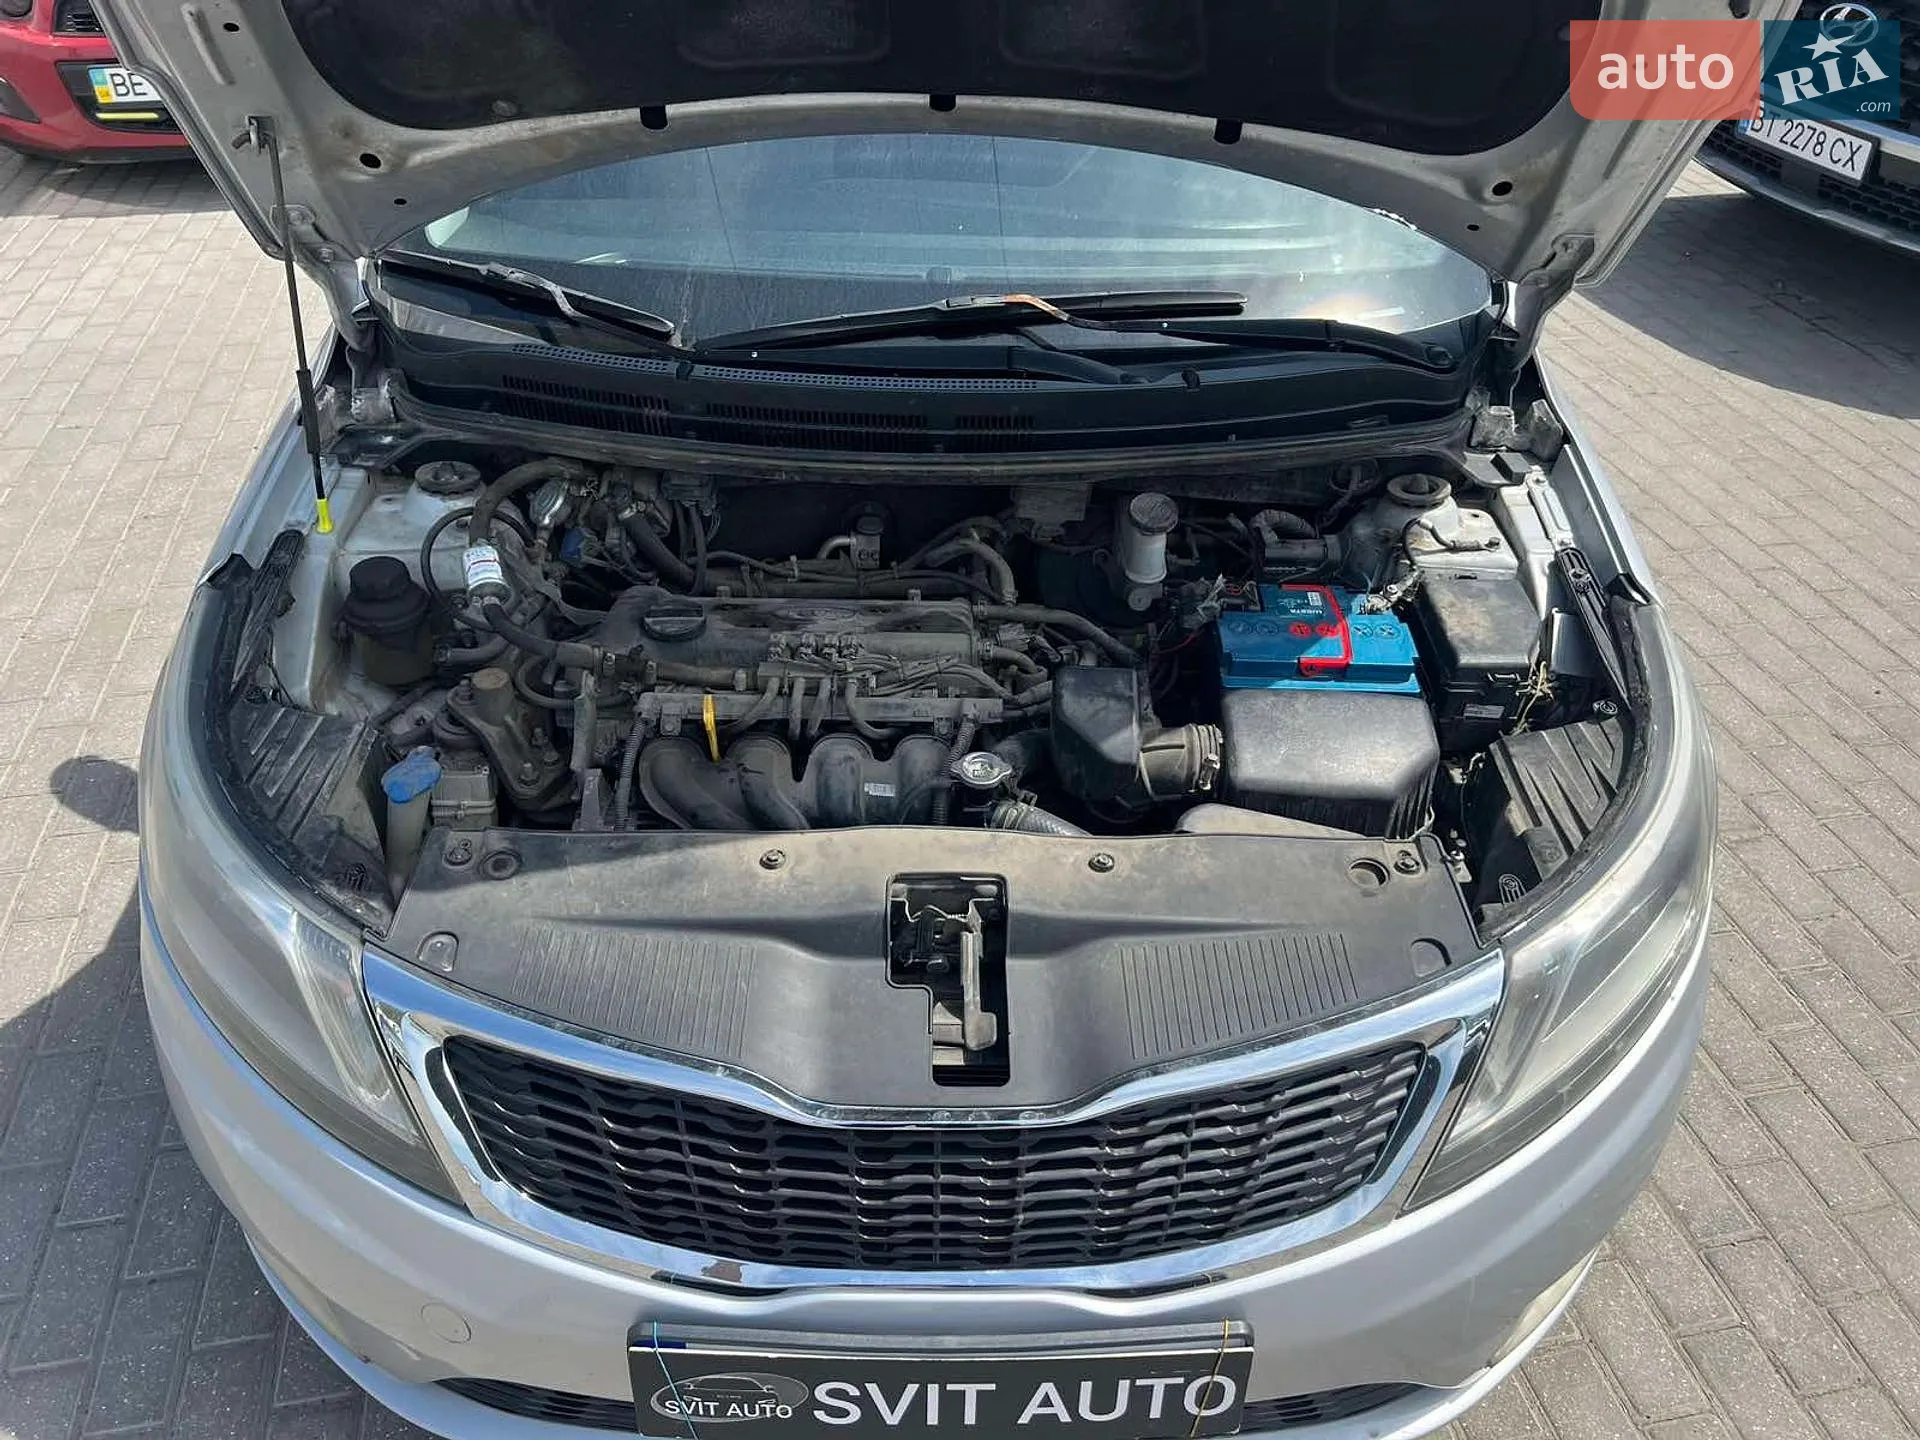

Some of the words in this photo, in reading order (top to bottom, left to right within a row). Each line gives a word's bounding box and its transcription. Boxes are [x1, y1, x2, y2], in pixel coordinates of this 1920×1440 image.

[109, 72, 148, 97] BE
[1751, 107, 1781, 137] BT
[1779, 119, 1827, 157] 2278
[1829, 138, 1862, 172] CX
[664, 1400, 720, 1416] SVIT
[726, 1401, 792, 1419] AUTO
[813, 1381, 997, 1425] SVIT
[1017, 1375, 1237, 1425] AUTO
